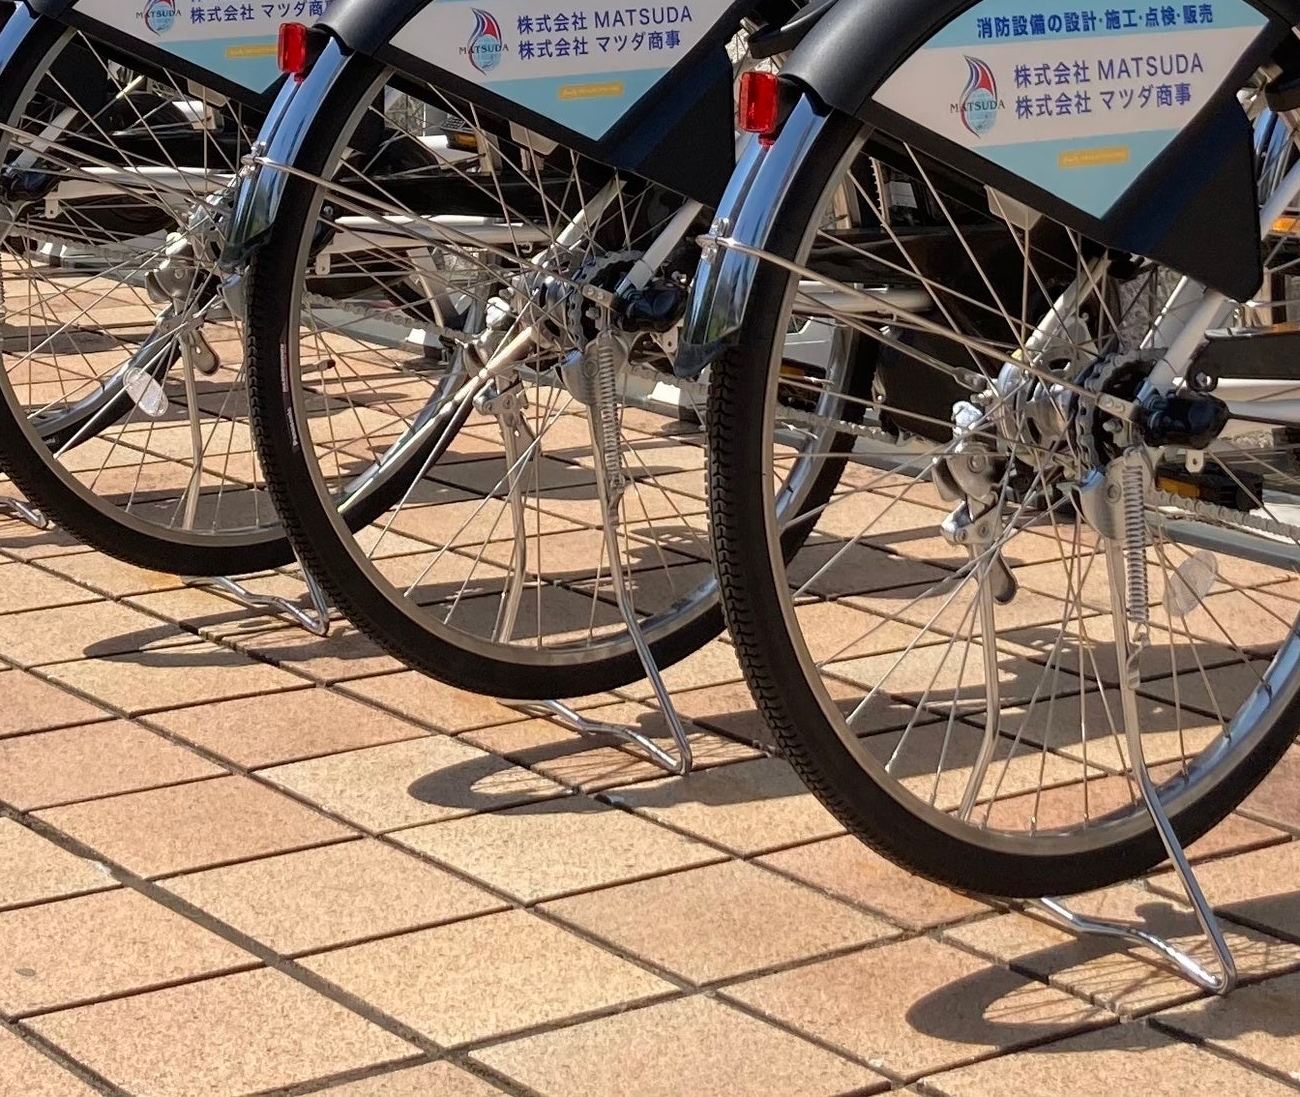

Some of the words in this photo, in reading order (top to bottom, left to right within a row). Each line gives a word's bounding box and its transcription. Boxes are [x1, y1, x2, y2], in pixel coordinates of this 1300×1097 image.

[136, 10, 182, 19] MATSUDA
[190, 4, 255, 24] 株式会社
[517, 11, 588, 35] 株式会社
[594, 5, 693, 28] MATSUDA
[459, 43, 509, 54] MATSUDA
[518, 37, 589, 60] 株式会社
[596, 30, 681, 53] マツダ商事
[1014, 60, 1091, 89] 株式会社
[1098, 52, 1204, 81] MATSUDA
[950, 99, 1006, 113] MATSUDA
[1015, 90, 1092, 119] 株式会社
[1100, 82, 1192, 111] マツダ商事
